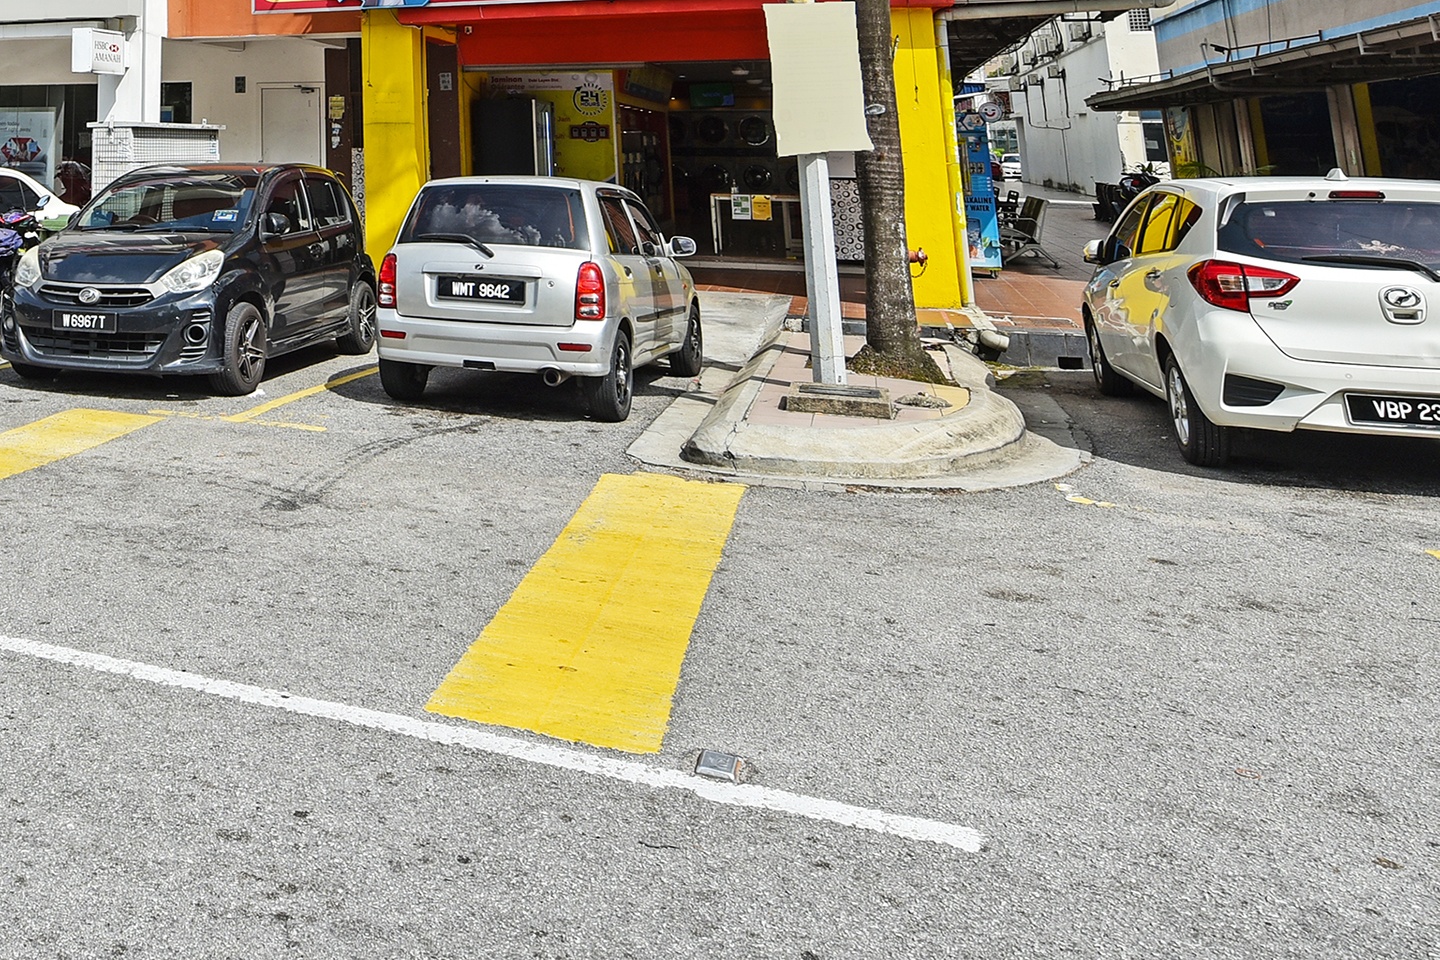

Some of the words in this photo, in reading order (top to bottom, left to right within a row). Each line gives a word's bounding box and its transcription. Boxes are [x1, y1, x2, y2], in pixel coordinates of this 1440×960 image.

[94, 40, 109, 51] HSBC
[94, 52, 121, 63] AMANAH
[580, 91, 599, 102] 24
[970, 204, 990, 212] WATER
[452, 281, 475, 296] WMT
[479, 283, 510, 299] 9642
[1373, 401, 1412, 420] VBP
